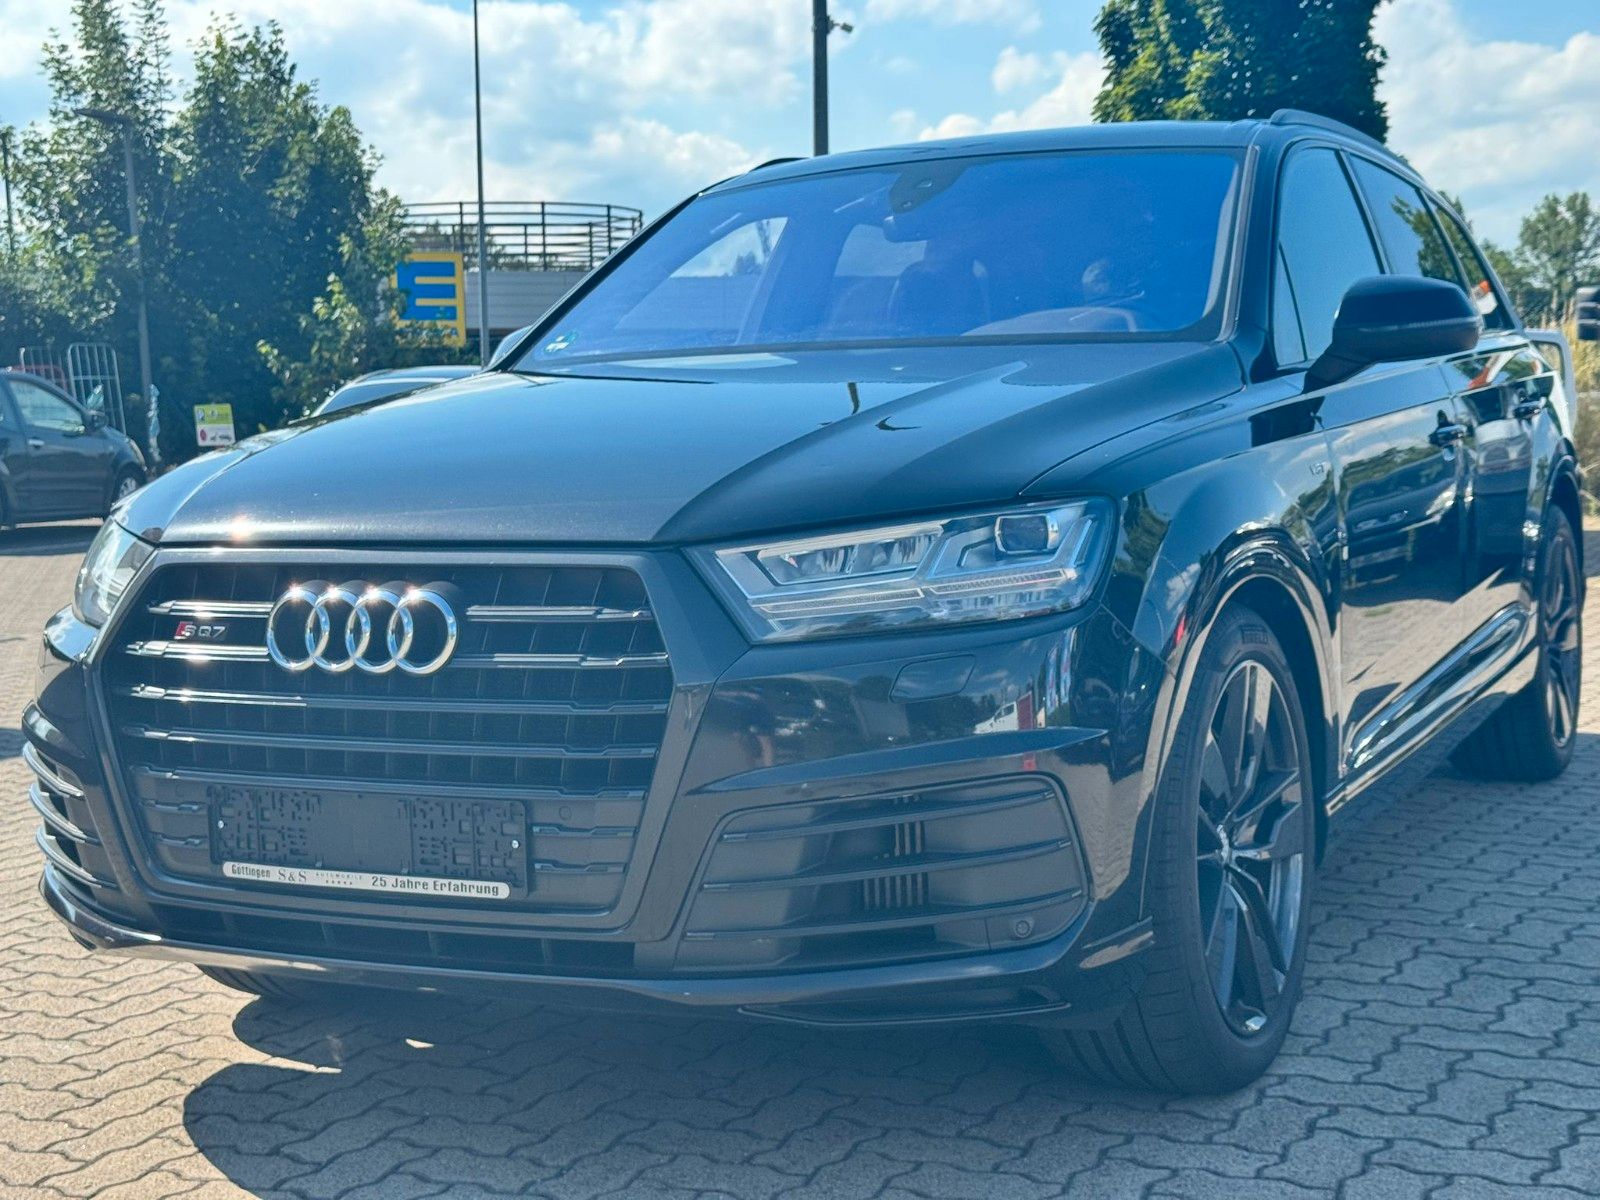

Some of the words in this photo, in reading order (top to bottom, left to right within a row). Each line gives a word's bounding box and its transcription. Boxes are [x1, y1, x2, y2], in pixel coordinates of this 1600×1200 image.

[397, 262, 456, 320] E
[178, 622, 225, 639] SQ7
[371, 875, 387, 887] 25
[391, 877, 429, 890] Jahre
[433, 880, 499, 896] Erfahrung
